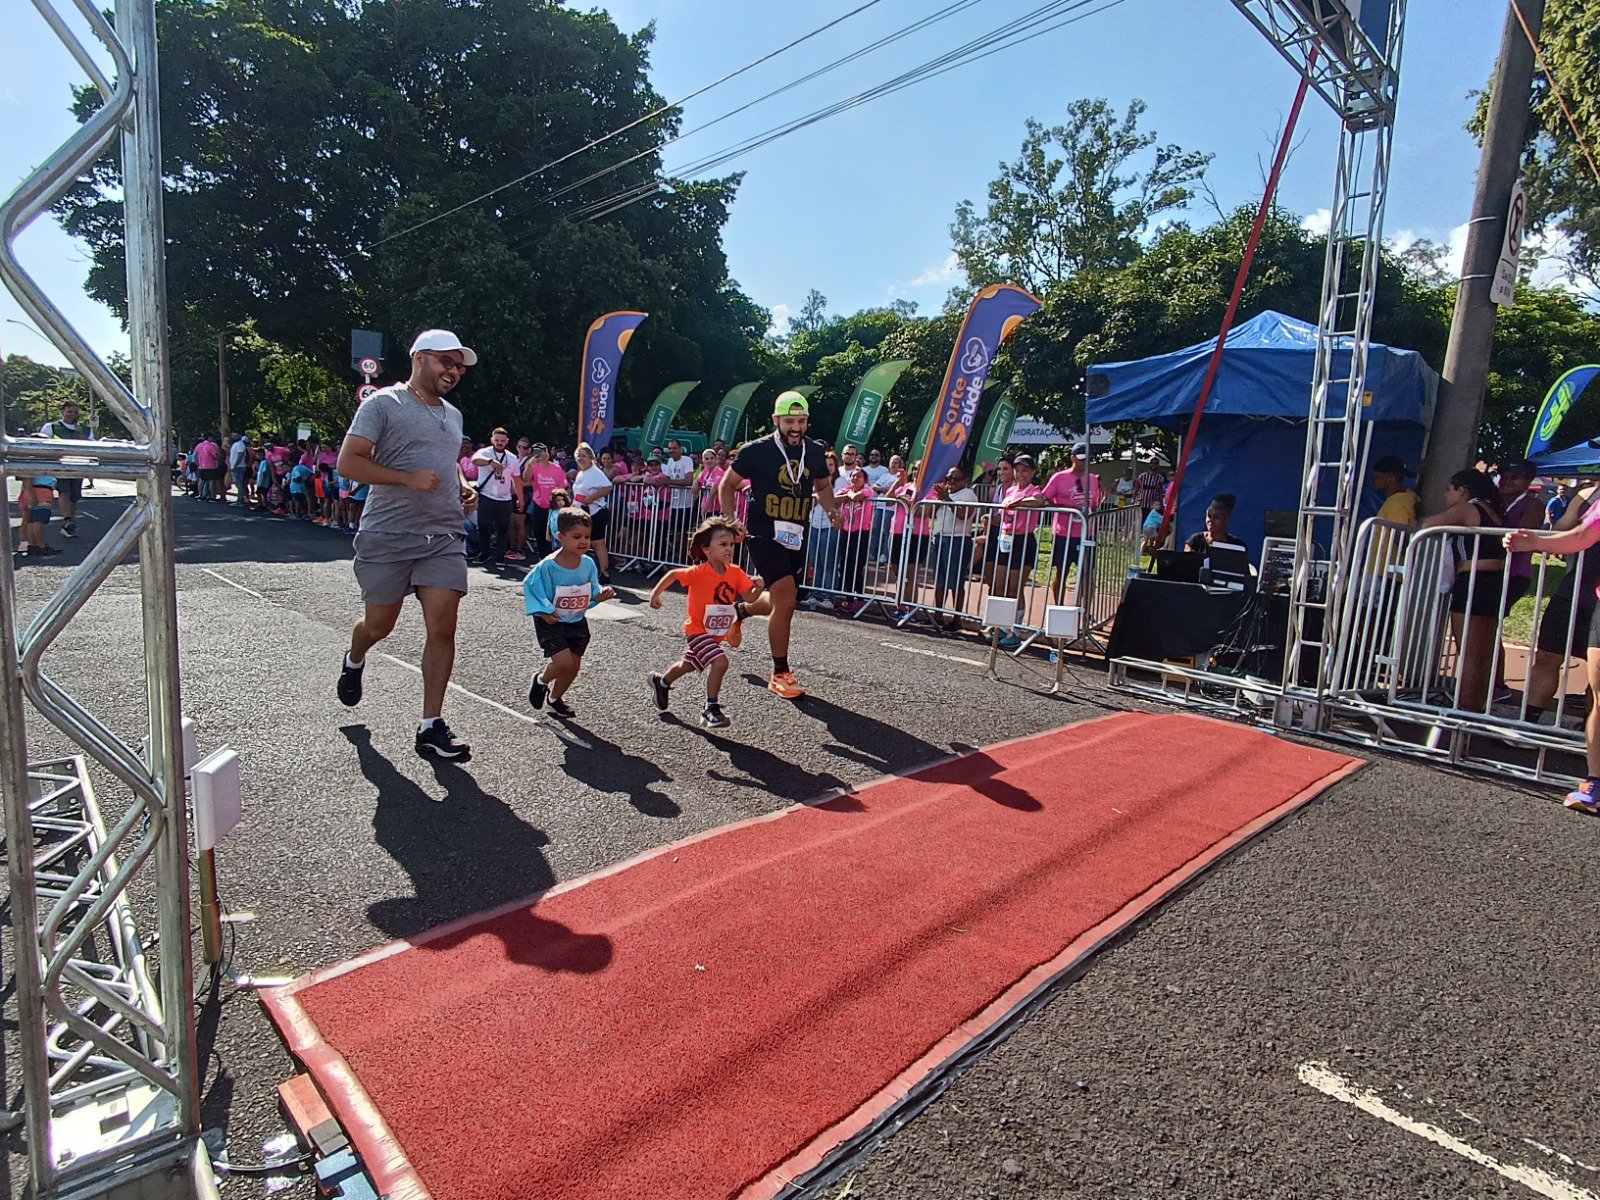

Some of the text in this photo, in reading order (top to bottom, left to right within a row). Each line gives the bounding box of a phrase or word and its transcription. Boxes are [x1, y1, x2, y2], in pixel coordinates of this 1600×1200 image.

[363, 361, 375, 369] 60
[587, 387, 605, 434] Sorte
[939, 377, 967, 448] Sorte
[560, 596, 586, 608] 633
[708, 616, 731, 628] 629
